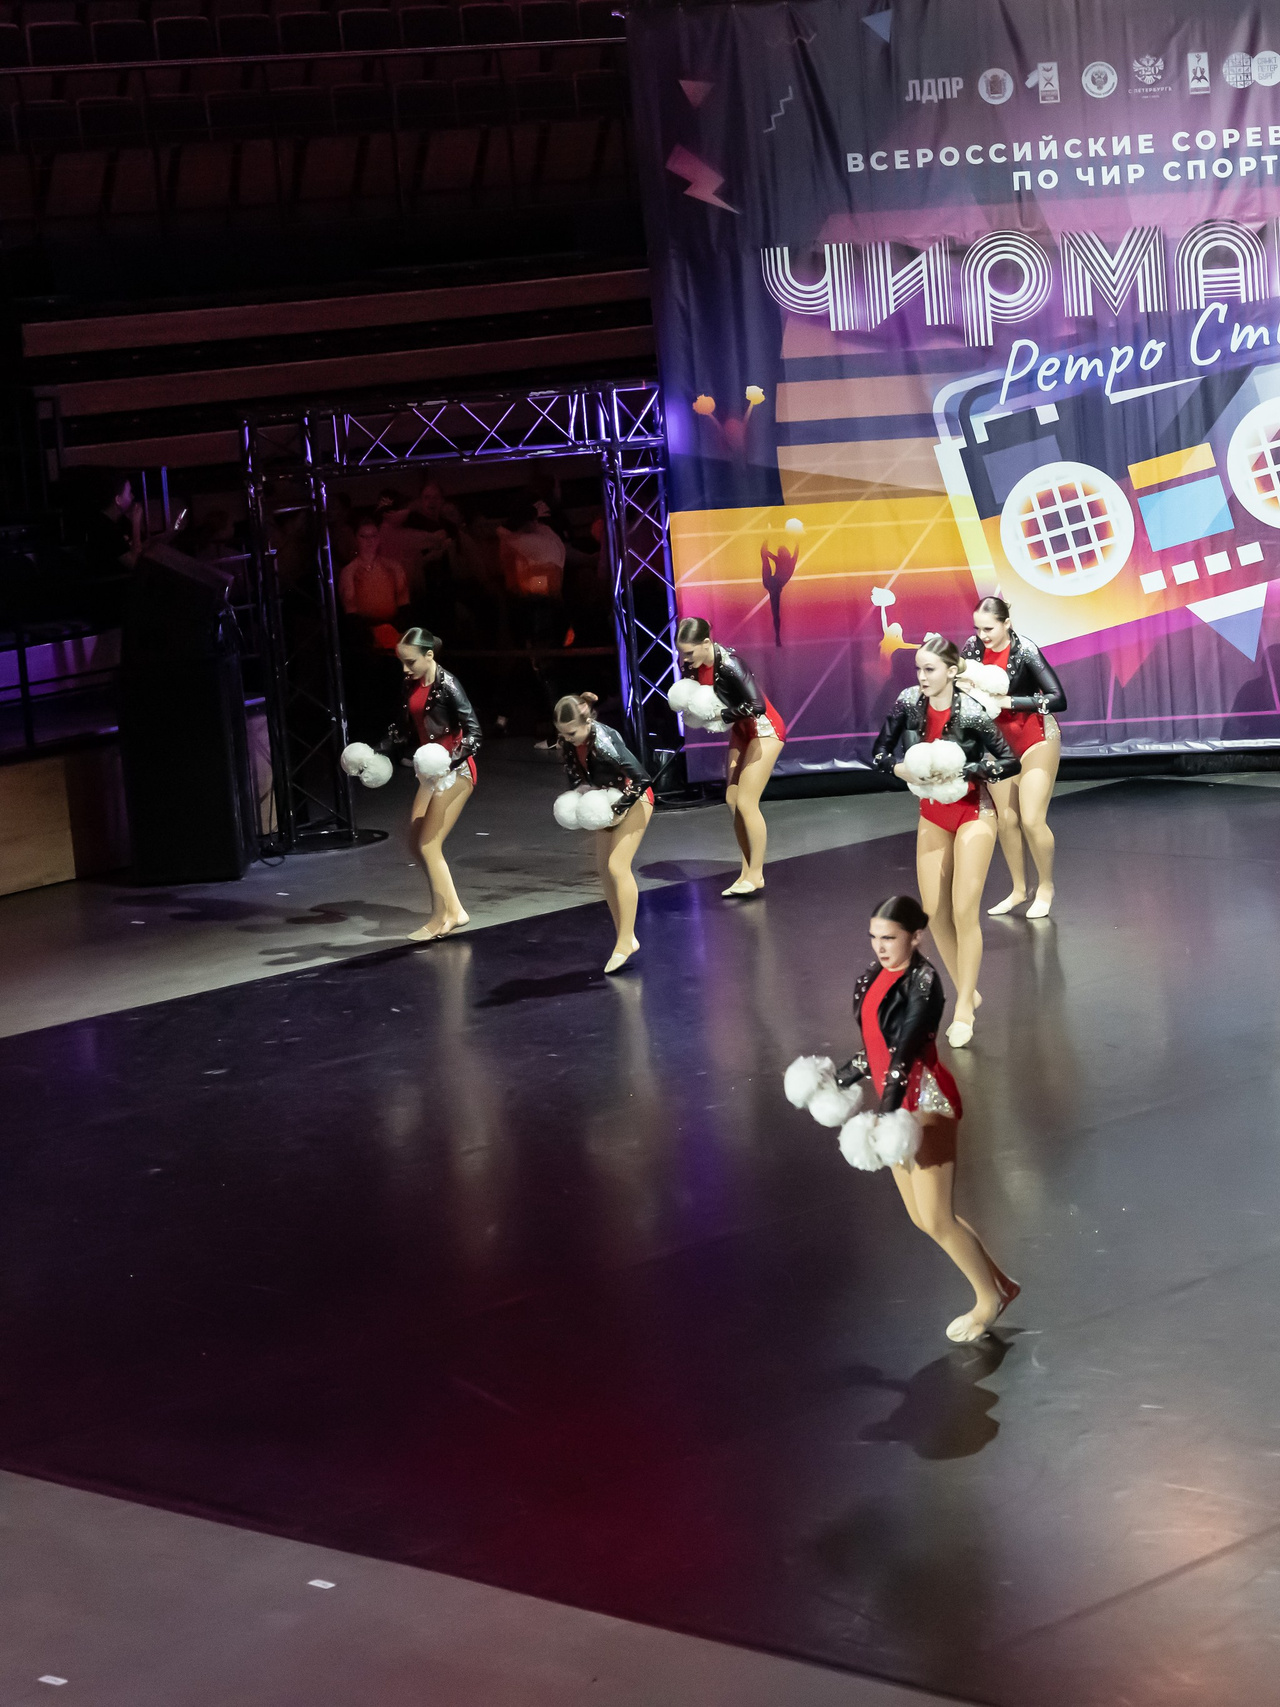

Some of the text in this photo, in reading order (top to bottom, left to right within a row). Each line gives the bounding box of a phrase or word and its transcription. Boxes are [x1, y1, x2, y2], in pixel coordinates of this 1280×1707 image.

[904, 77, 964, 104] ЛДПР
[846, 134, 1154, 173] ВСЕРОССИЙСКИЕ
[1012, 169, 1059, 191] ПО
[1076, 164, 1145, 187] ЧИР
[999, 338, 1166, 405] Ретро
